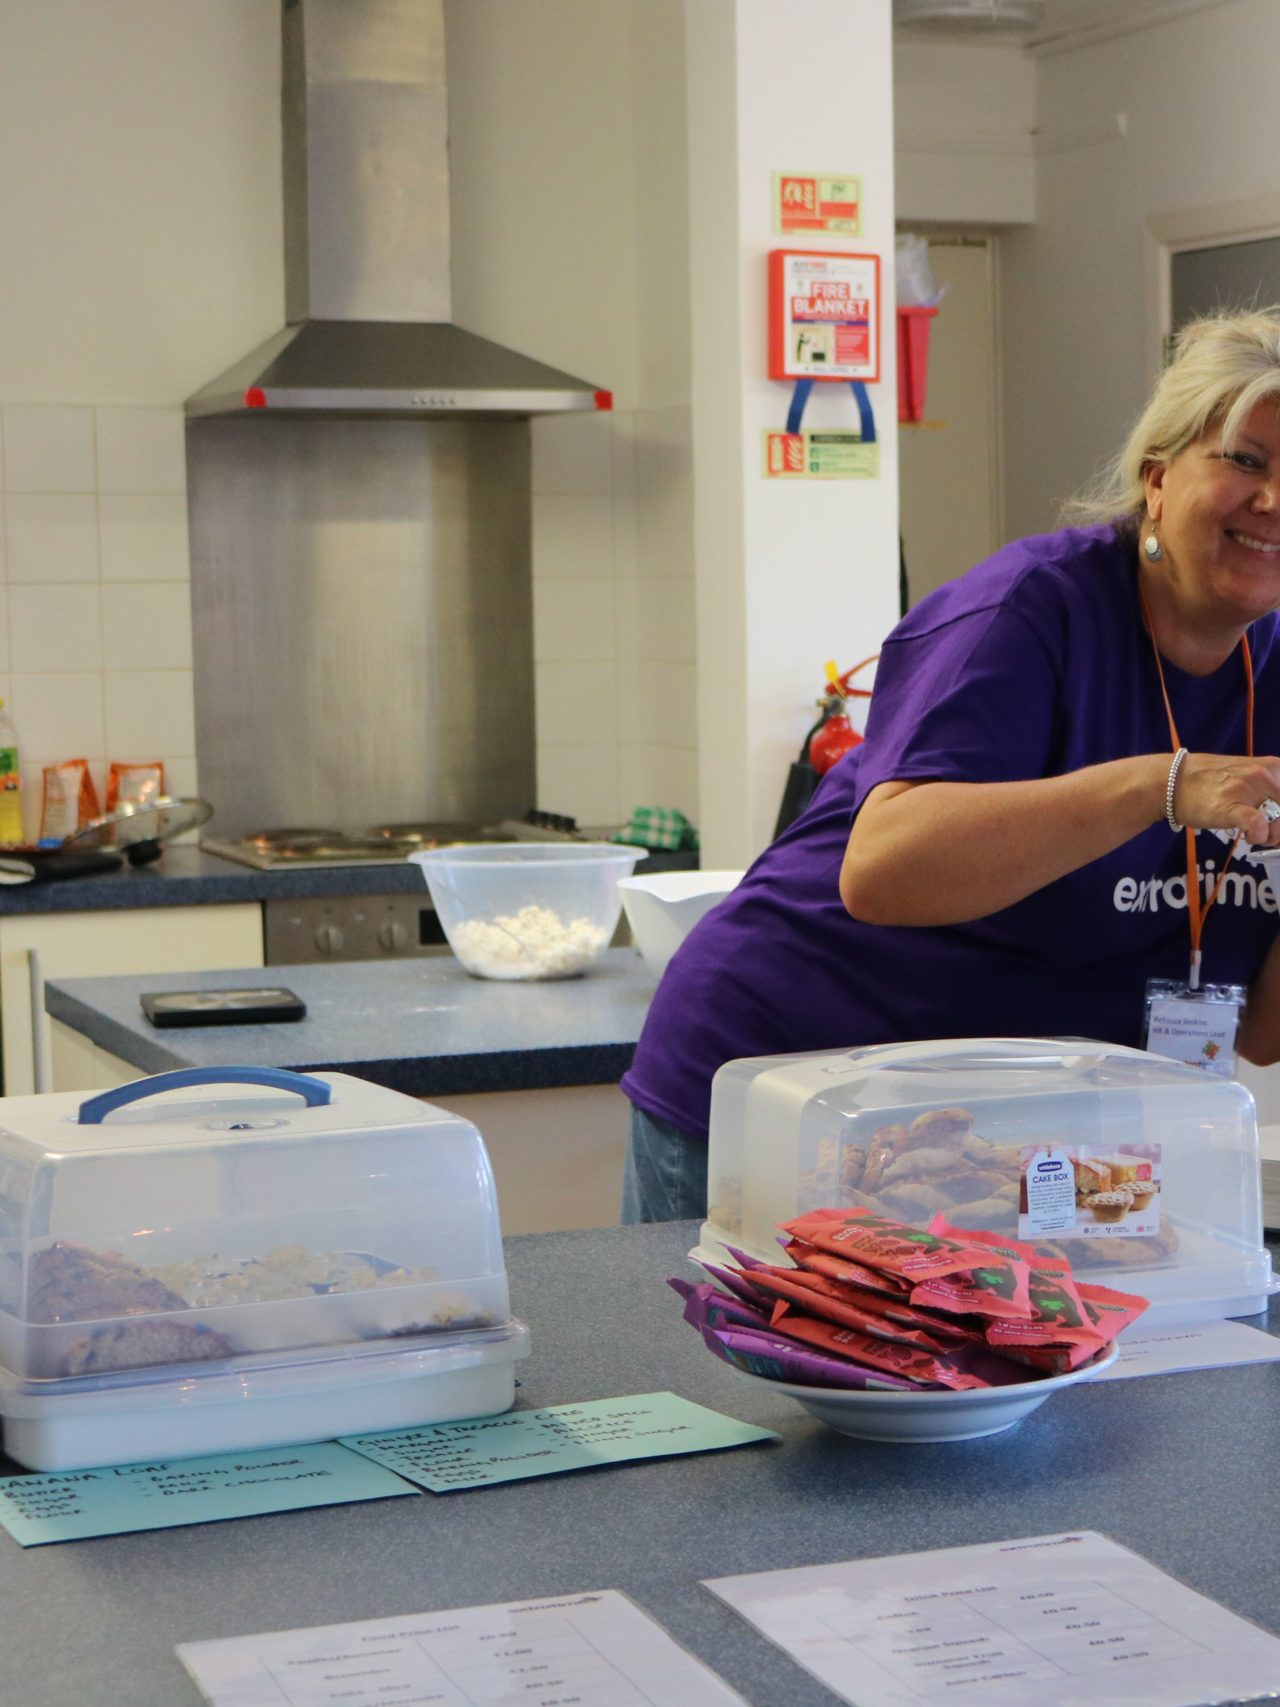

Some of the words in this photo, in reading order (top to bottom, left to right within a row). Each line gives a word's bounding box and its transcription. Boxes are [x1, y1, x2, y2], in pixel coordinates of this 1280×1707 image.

[812, 283, 848, 299] FIRE
[793, 298, 866, 314] BLANKET
[1032, 1174, 1052, 1183] CAKE
[1053, 1173, 1069, 1182] BOX
[224, 1470, 333, 1487] CHOCOLATE
